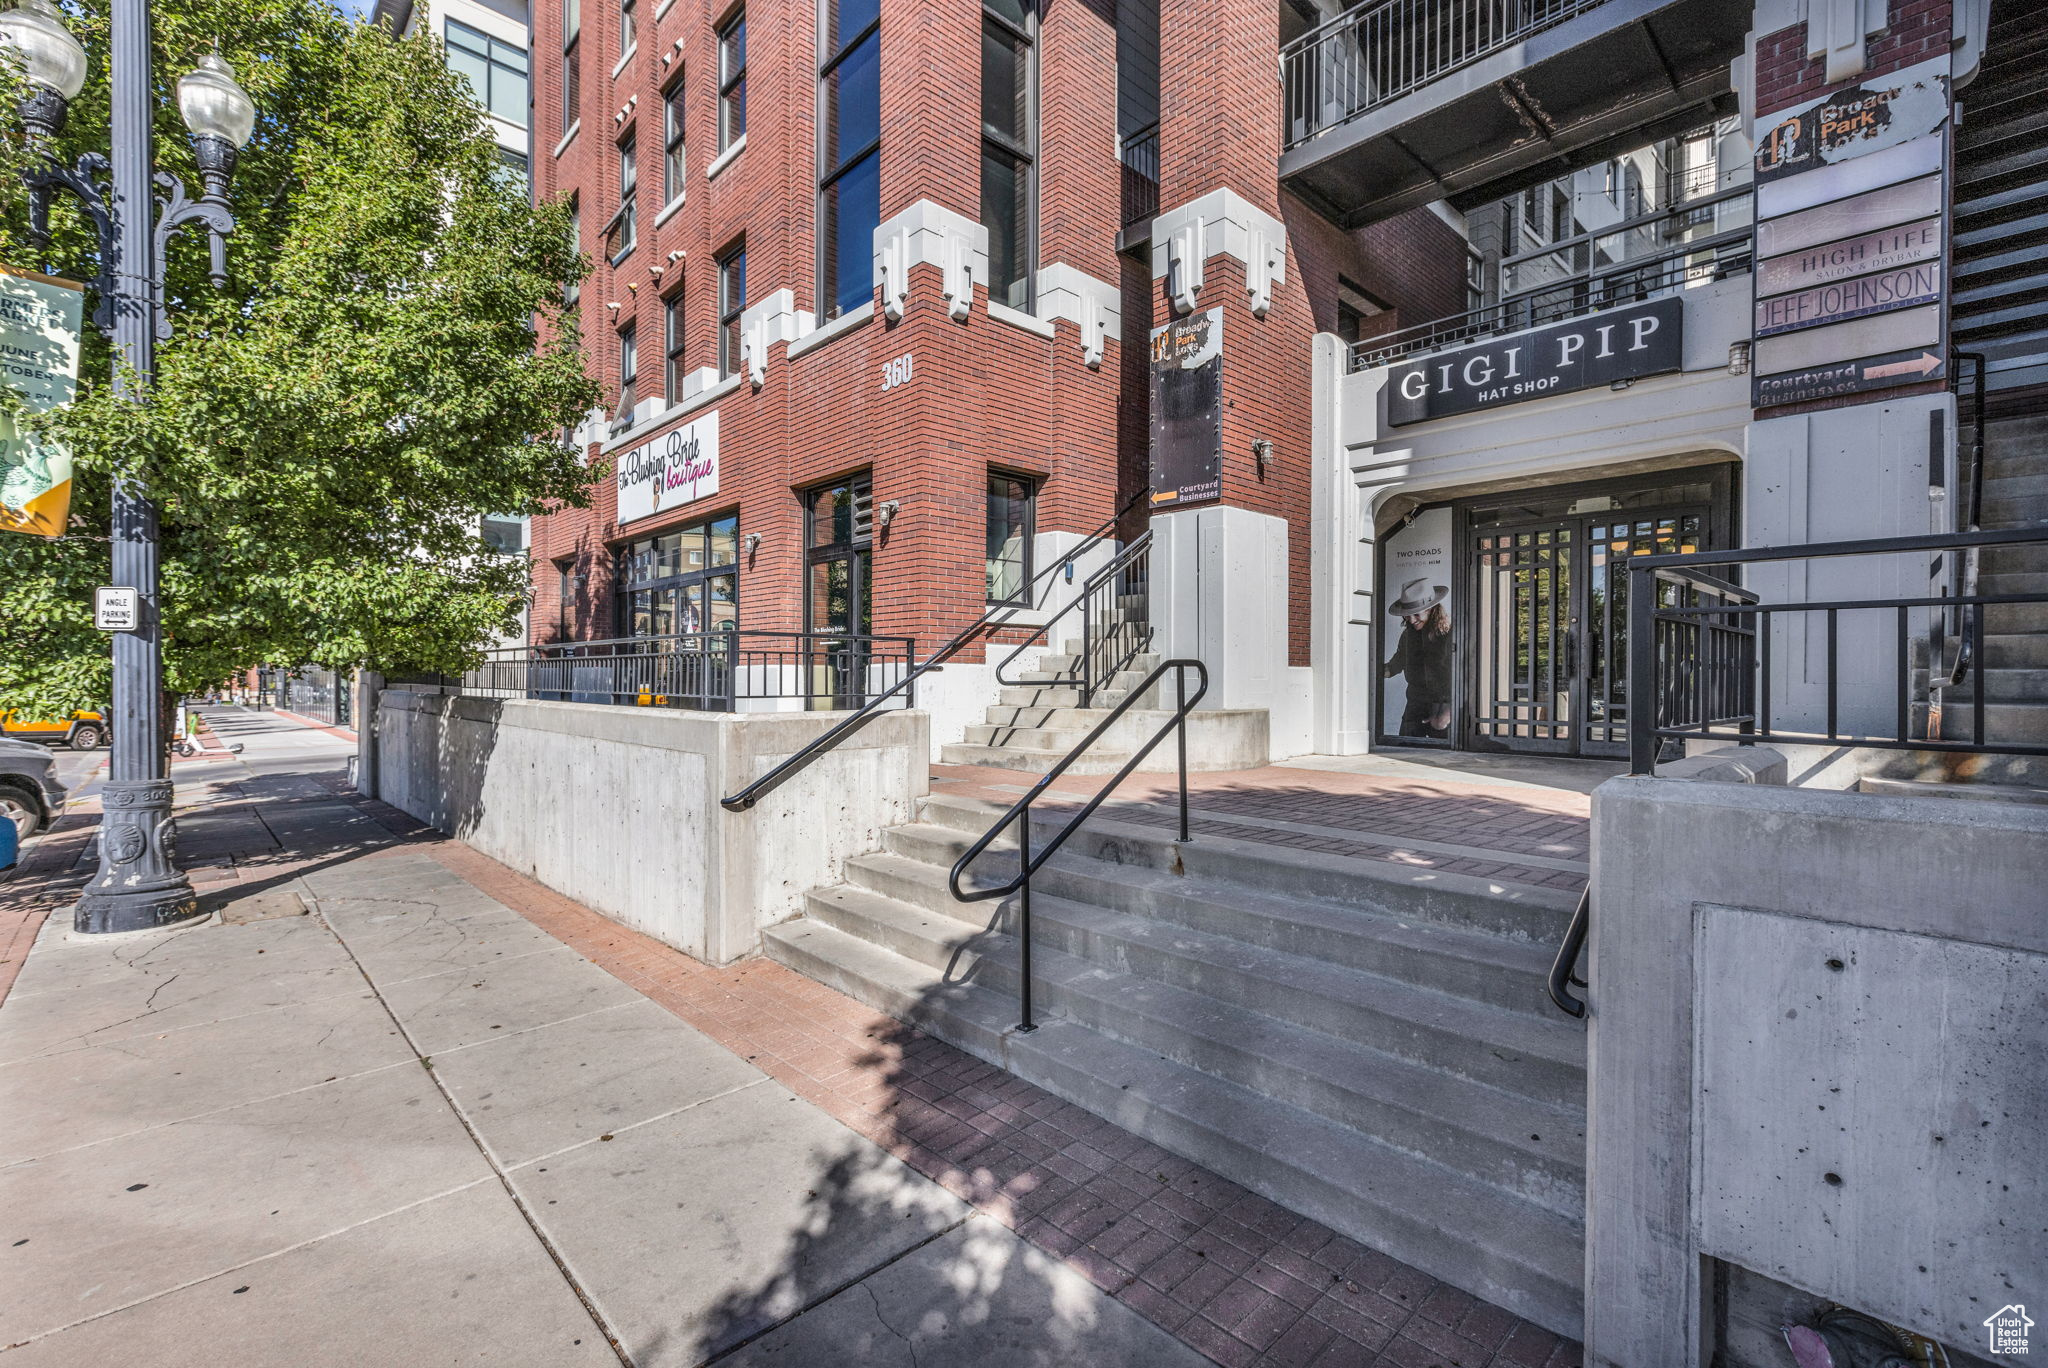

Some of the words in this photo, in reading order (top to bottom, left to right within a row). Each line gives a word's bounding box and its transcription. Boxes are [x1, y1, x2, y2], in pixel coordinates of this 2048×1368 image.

[1821, 110, 1876, 140] Park
[1802, 244, 1864, 273] HIGH
[1878, 227, 1934, 255] LIFE
[1816, 265, 1853, 280] SALON
[1858, 262, 1867, 271] &
[1872, 249, 1921, 268] DRYBAR
[1761, 293, 1809, 328] JEFF
[1814, 266, 1933, 317] JOHNSON
[1853, 297, 1924, 316] STUDIO
[1176, 332, 1196, 345] Park
[0, 345, 38, 360] JUNE
[1400, 347, 1522, 400] GIGI
[1556, 316, 1660, 367] PIP
[881, 353, 913, 391] 360
[1760, 364, 1856, 391] Courtyard
[1478, 386, 1508, 402] HAT
[1513, 375, 1560, 395] SHOP
[619, 470, 629, 490] The
[626, 442, 666, 495] Blushing
[666, 424, 700, 468] Bride
[666, 458, 714, 500] boutique
[1180, 480, 1218, 493] Courtyard
[1180, 490, 1218, 502] Businesses
[1397, 550, 1413, 558] TWO
[1415, 548, 1442, 556] ROADS
[101, 610, 131, 619] PARKING
[106, 598, 128, 606] ANGLE
